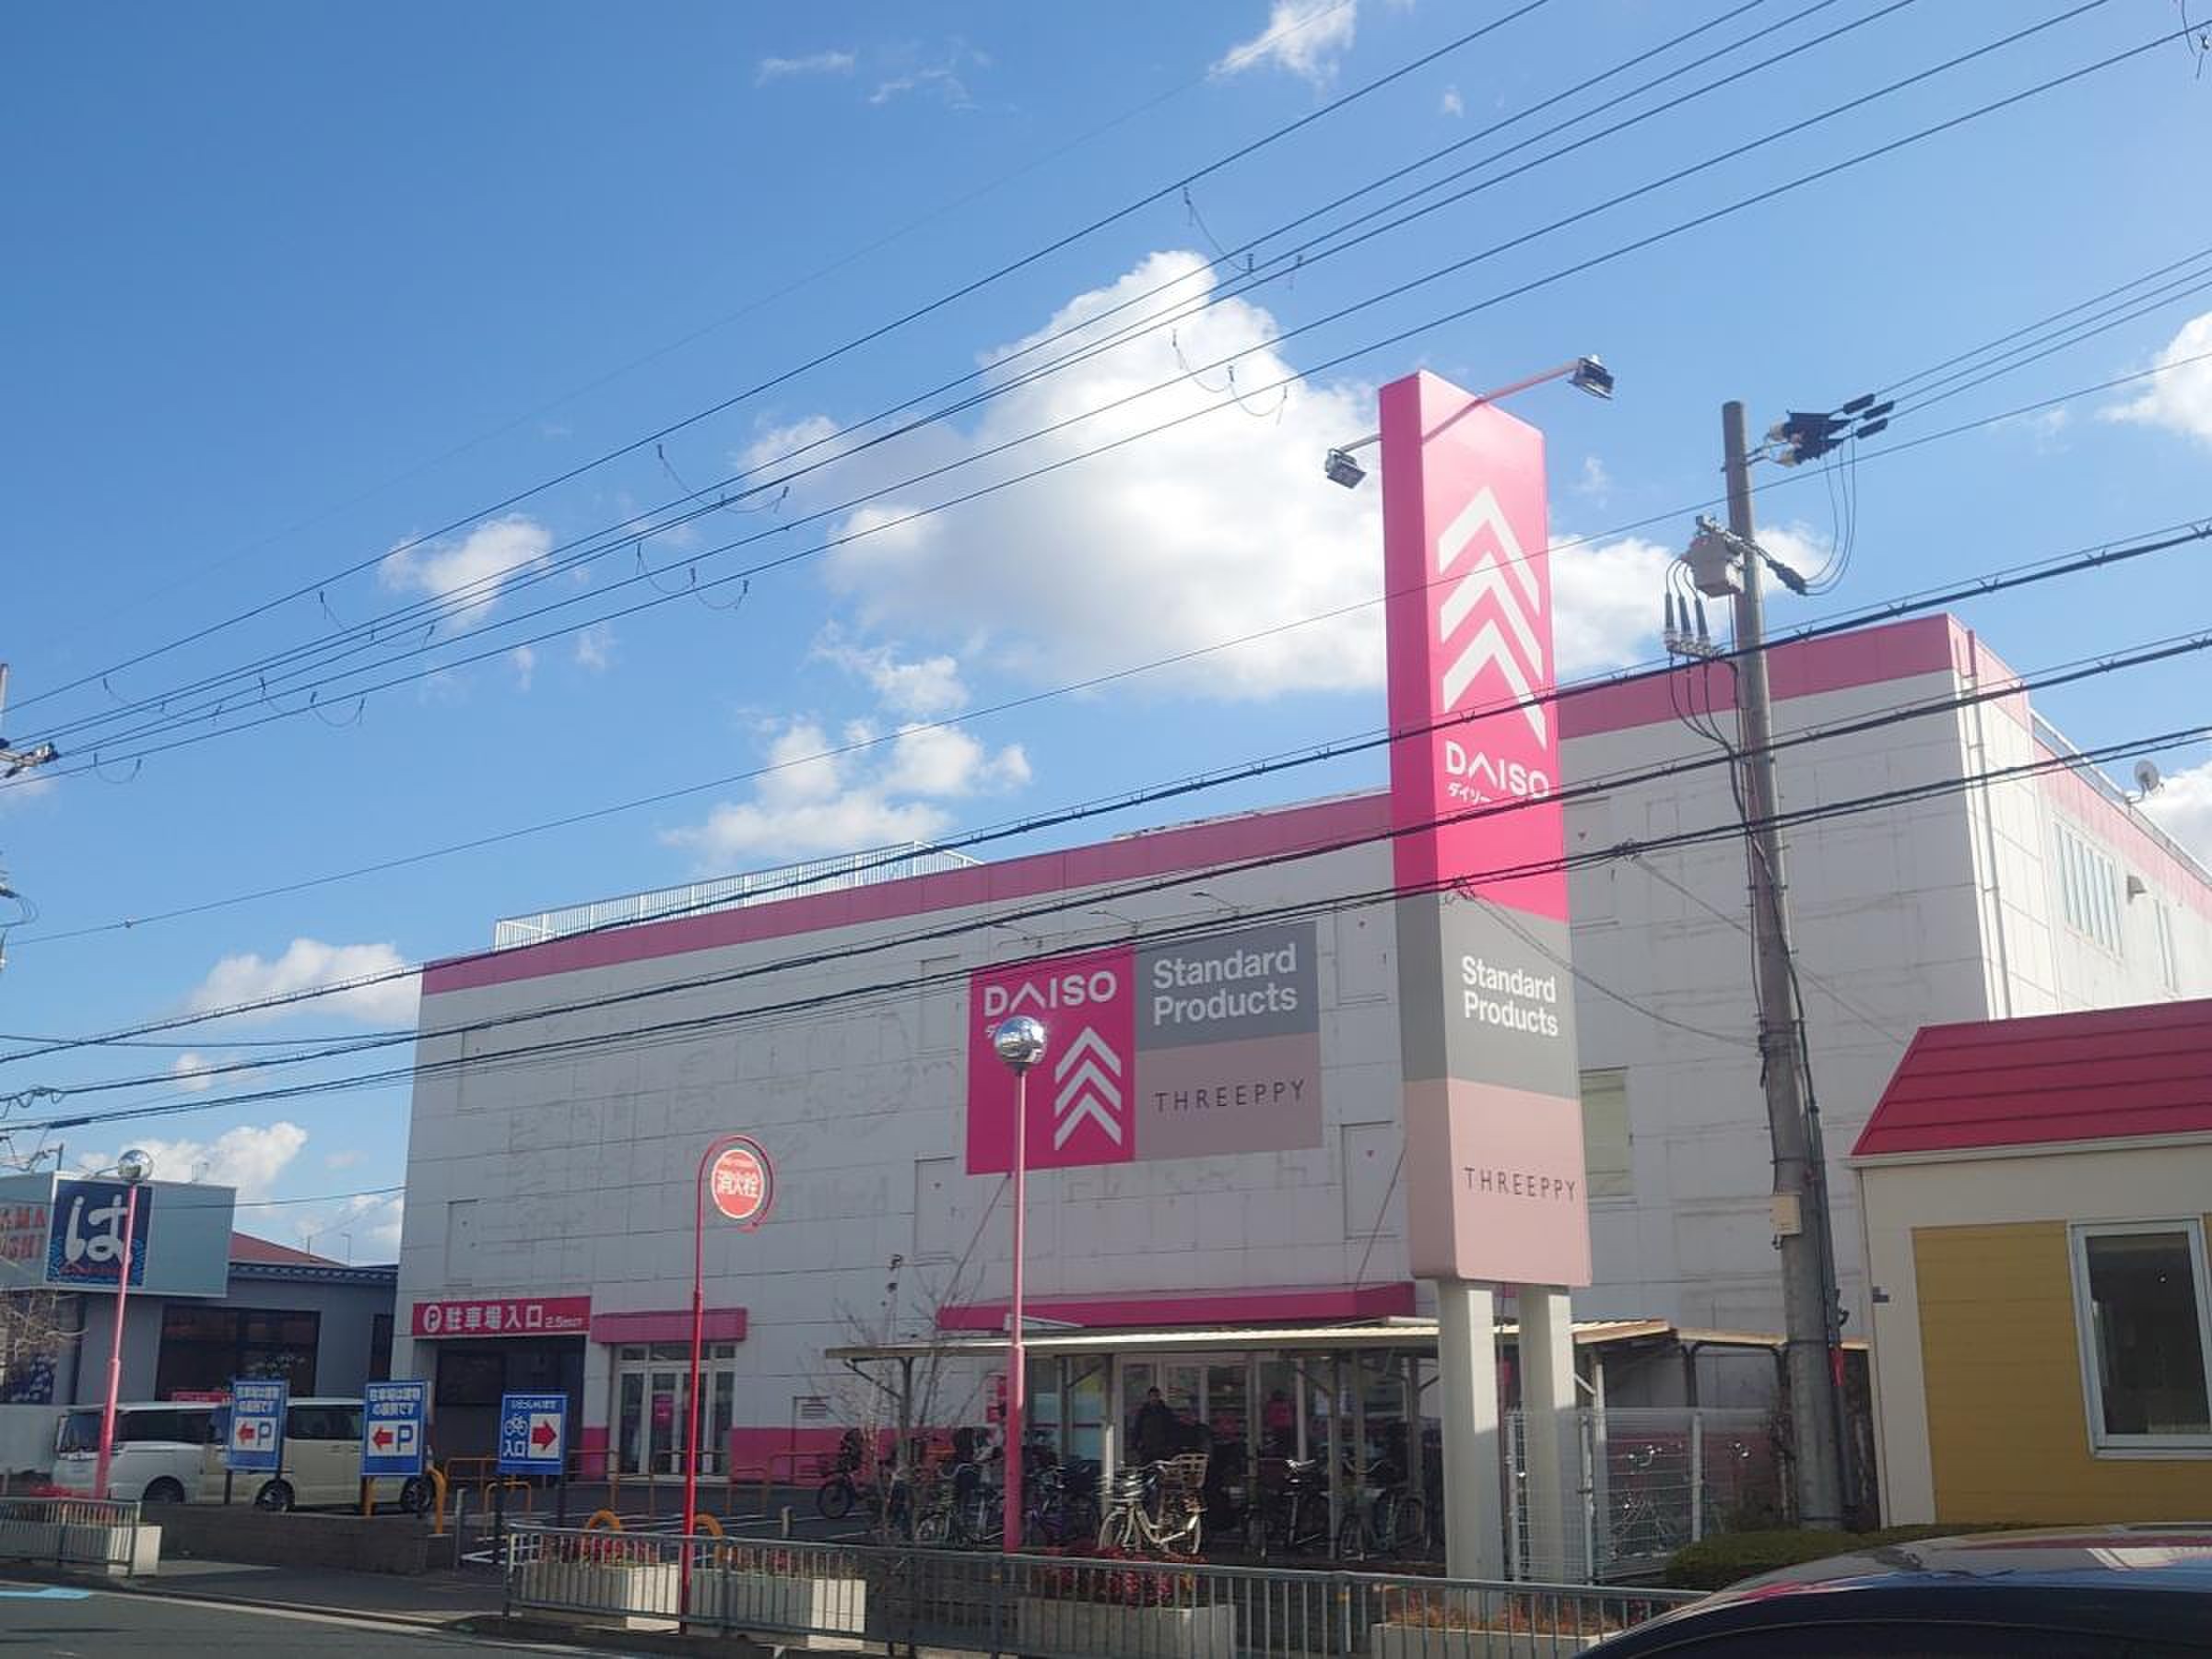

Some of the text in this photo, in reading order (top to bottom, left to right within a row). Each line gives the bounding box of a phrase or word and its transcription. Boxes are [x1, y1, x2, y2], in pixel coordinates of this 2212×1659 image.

[1445, 740, 1549, 800] DAISO
[1448, 781, 1491, 806] ダイソー
[1153, 942, 1298, 990] Standard
[1462, 955, 1556, 1004] Standard
[984, 971, 1118, 1018] DAISO
[1153, 982, 1299, 1026] Products
[1464, 989, 1559, 1037] Products
[1154, 1077, 1305, 1112] THREEPPY
[717, 1168, 759, 1197] 消火栓
[1463, 1166, 1576, 1202] THREEPPY
[64, 1194, 134, 1266] は
[445, 1305, 544, 1330] 駐車場入口
[258, 1421, 273, 1446] P
[397, 1424, 414, 1452] P
[502, 1440, 526, 1457] 入口
